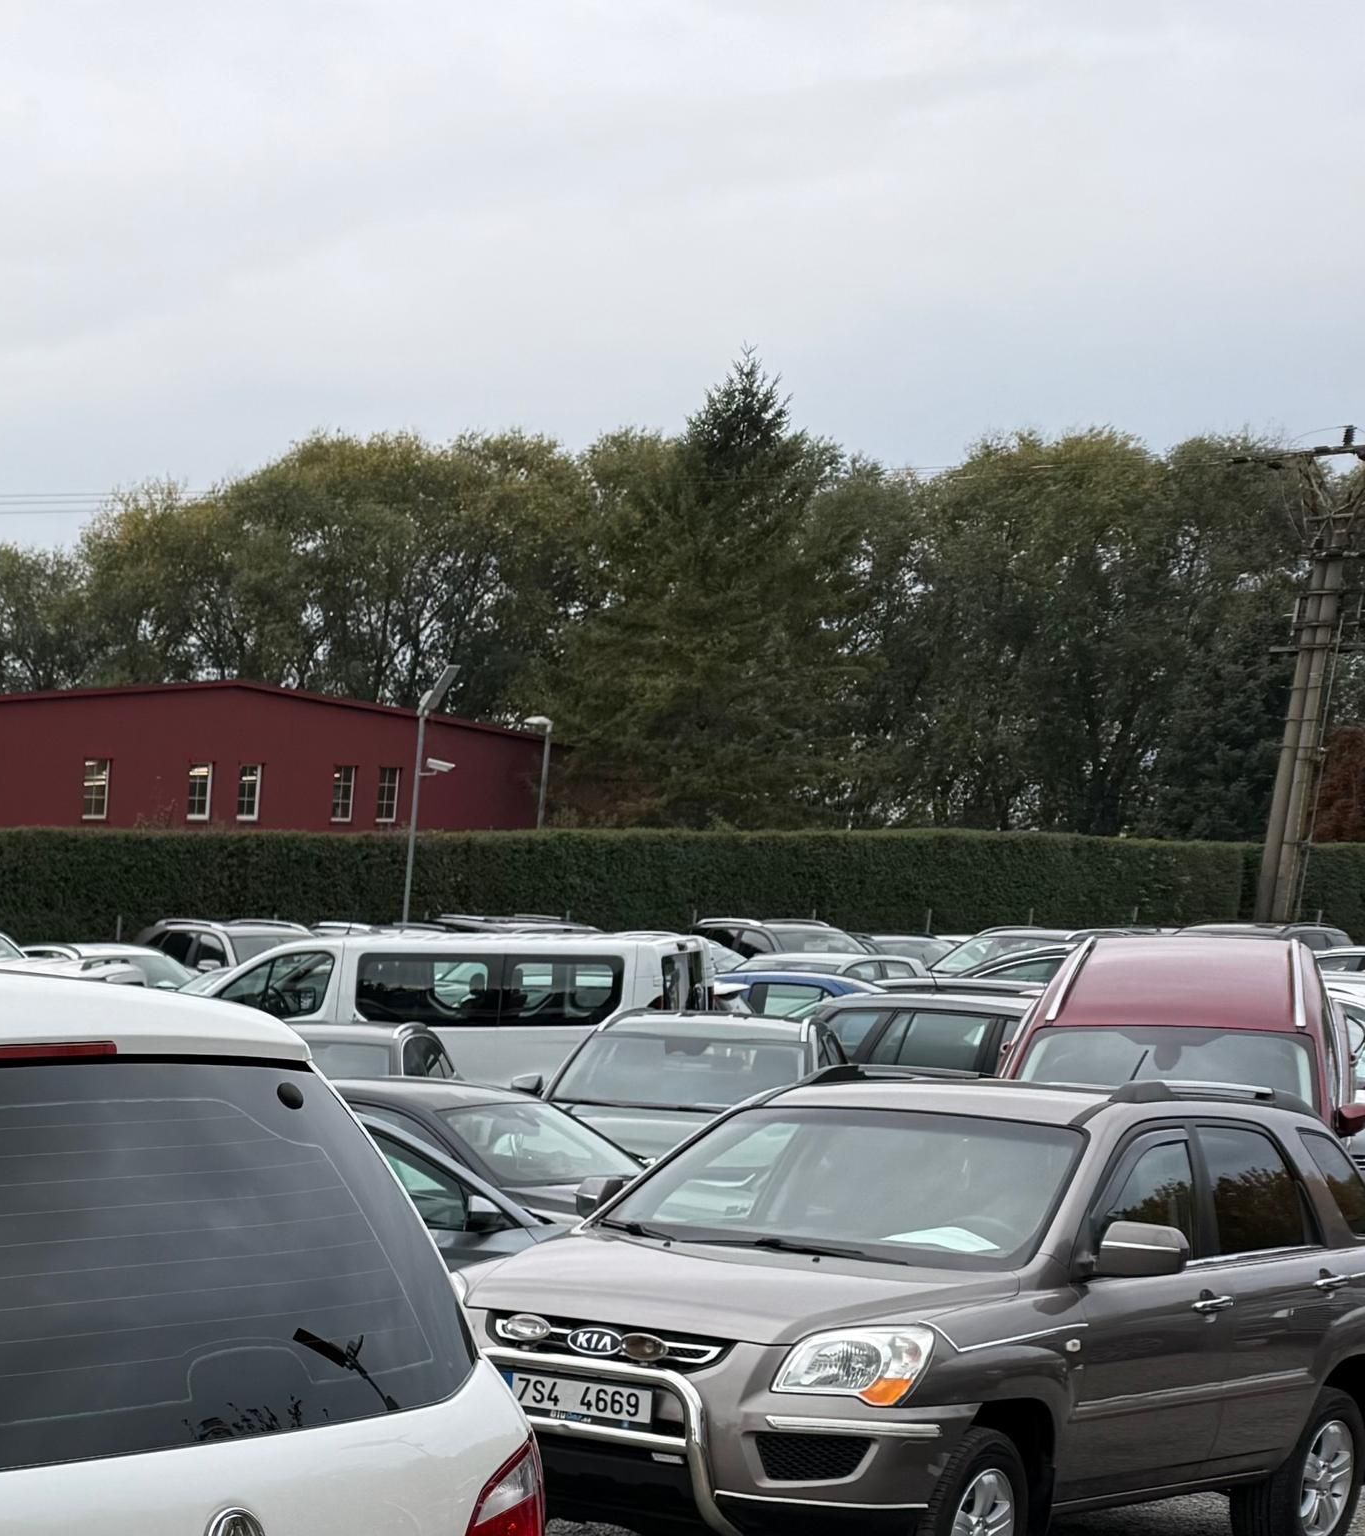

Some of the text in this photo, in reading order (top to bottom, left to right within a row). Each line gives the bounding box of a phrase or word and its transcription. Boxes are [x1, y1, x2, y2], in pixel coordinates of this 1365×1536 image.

[576, 1332, 612, 1351] KIA
[518, 1377, 640, 1417] 7S4 4669
